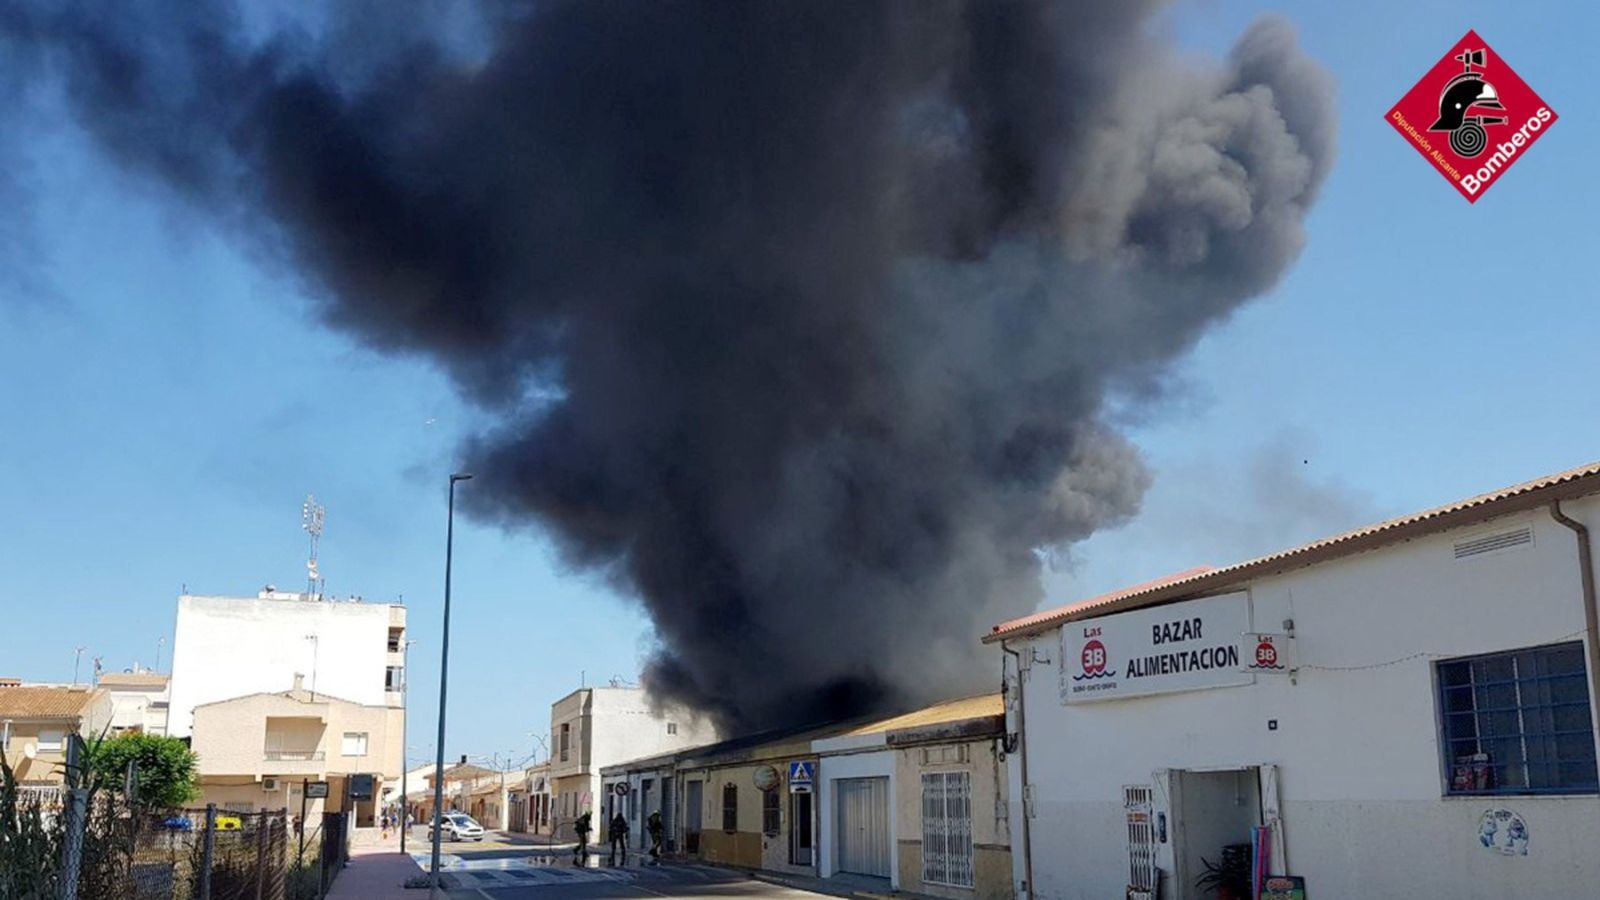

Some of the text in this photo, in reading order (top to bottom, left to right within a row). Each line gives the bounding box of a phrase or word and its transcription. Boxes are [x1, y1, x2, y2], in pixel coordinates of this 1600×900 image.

[1083, 627, 1102, 638] Las
[1152, 617, 1203, 645] BAZAR
[1257, 635, 1273, 643] Las
[1083, 648, 1104, 667] 3B
[1126, 645, 1239, 679] ALIMENTACION
[1257, 648, 1275, 661] 3B
